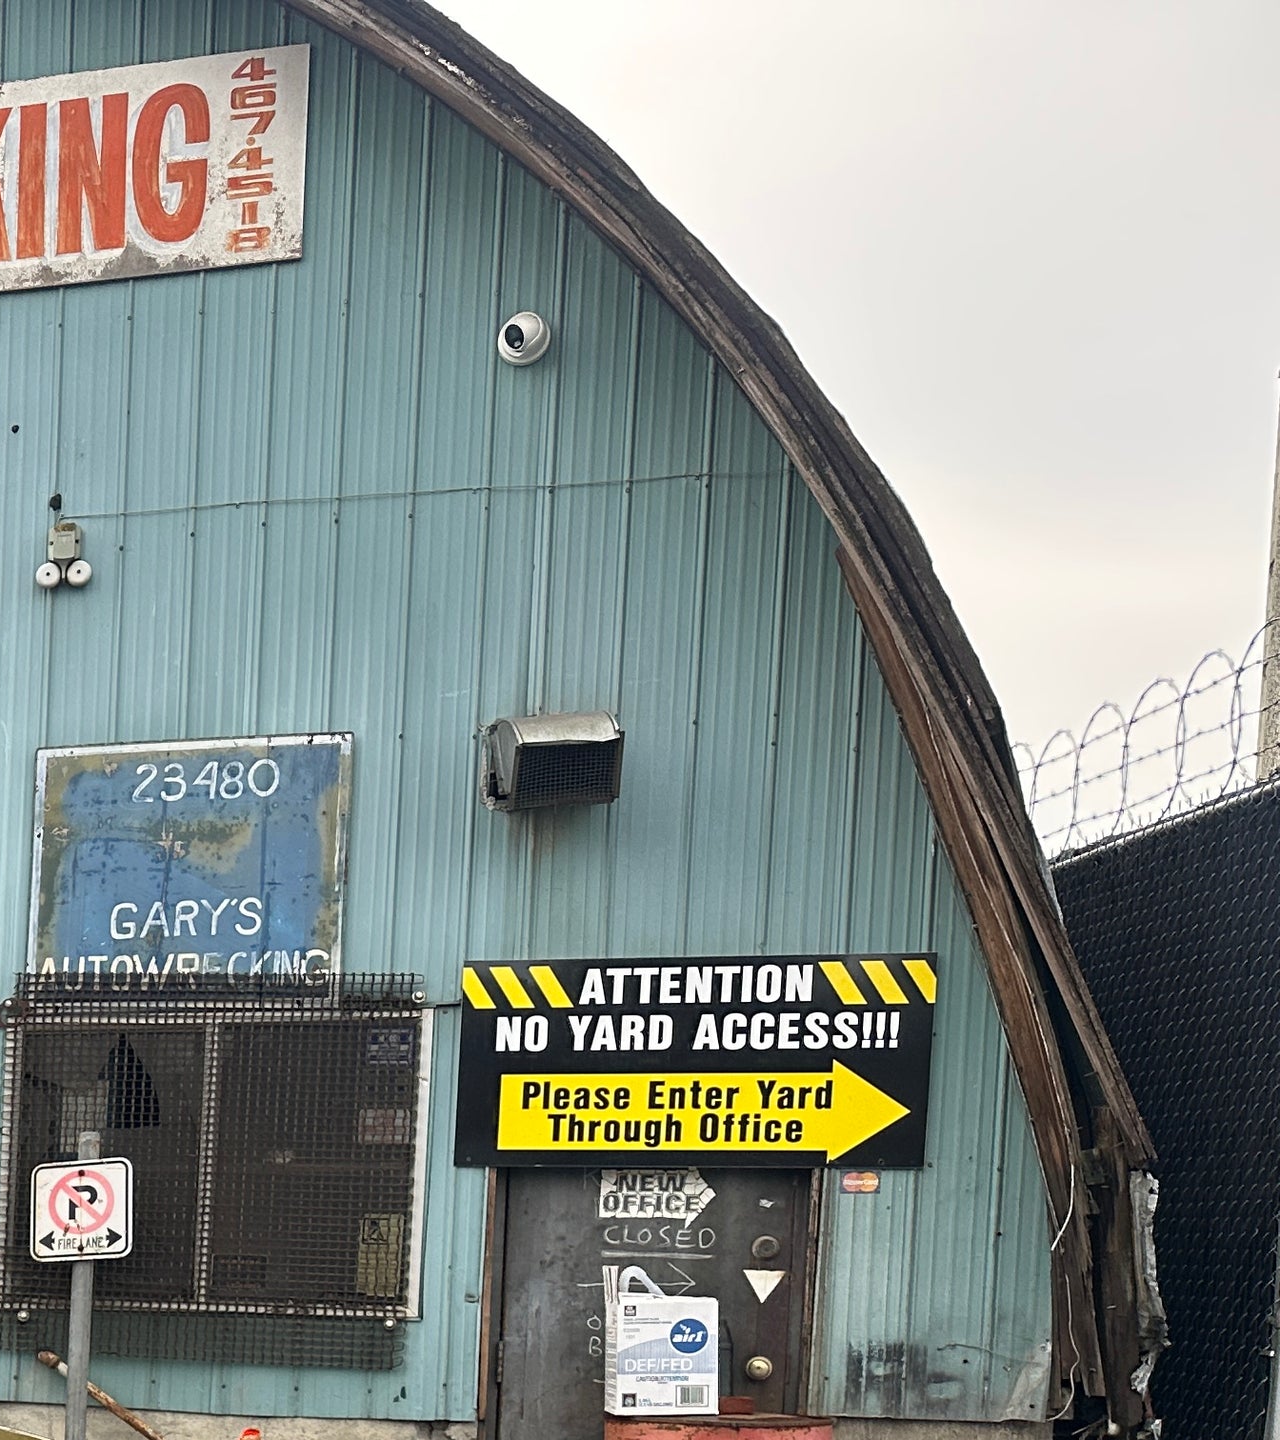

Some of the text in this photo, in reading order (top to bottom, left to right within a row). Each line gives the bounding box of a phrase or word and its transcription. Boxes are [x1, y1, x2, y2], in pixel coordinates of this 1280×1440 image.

[131, 758, 280, 803] 23480
[110, 896, 263, 940] GARY'S
[579, 964, 814, 1007] ATTENTION
[495, 1011, 901, 1053] NO YARD ACCESS!!!
[522, 1080, 833, 1110] Please Enter Yard
[548, 1112, 803, 1147] Through Office
[617, 1173, 687, 1193] NEW
[602, 1194, 700, 1213] OFFICE
[58, 1238, 77, 1250] FIRE
[602, 1225, 716, 1249] CLOSED
[624, 1358, 693, 1372] DEF/FED
